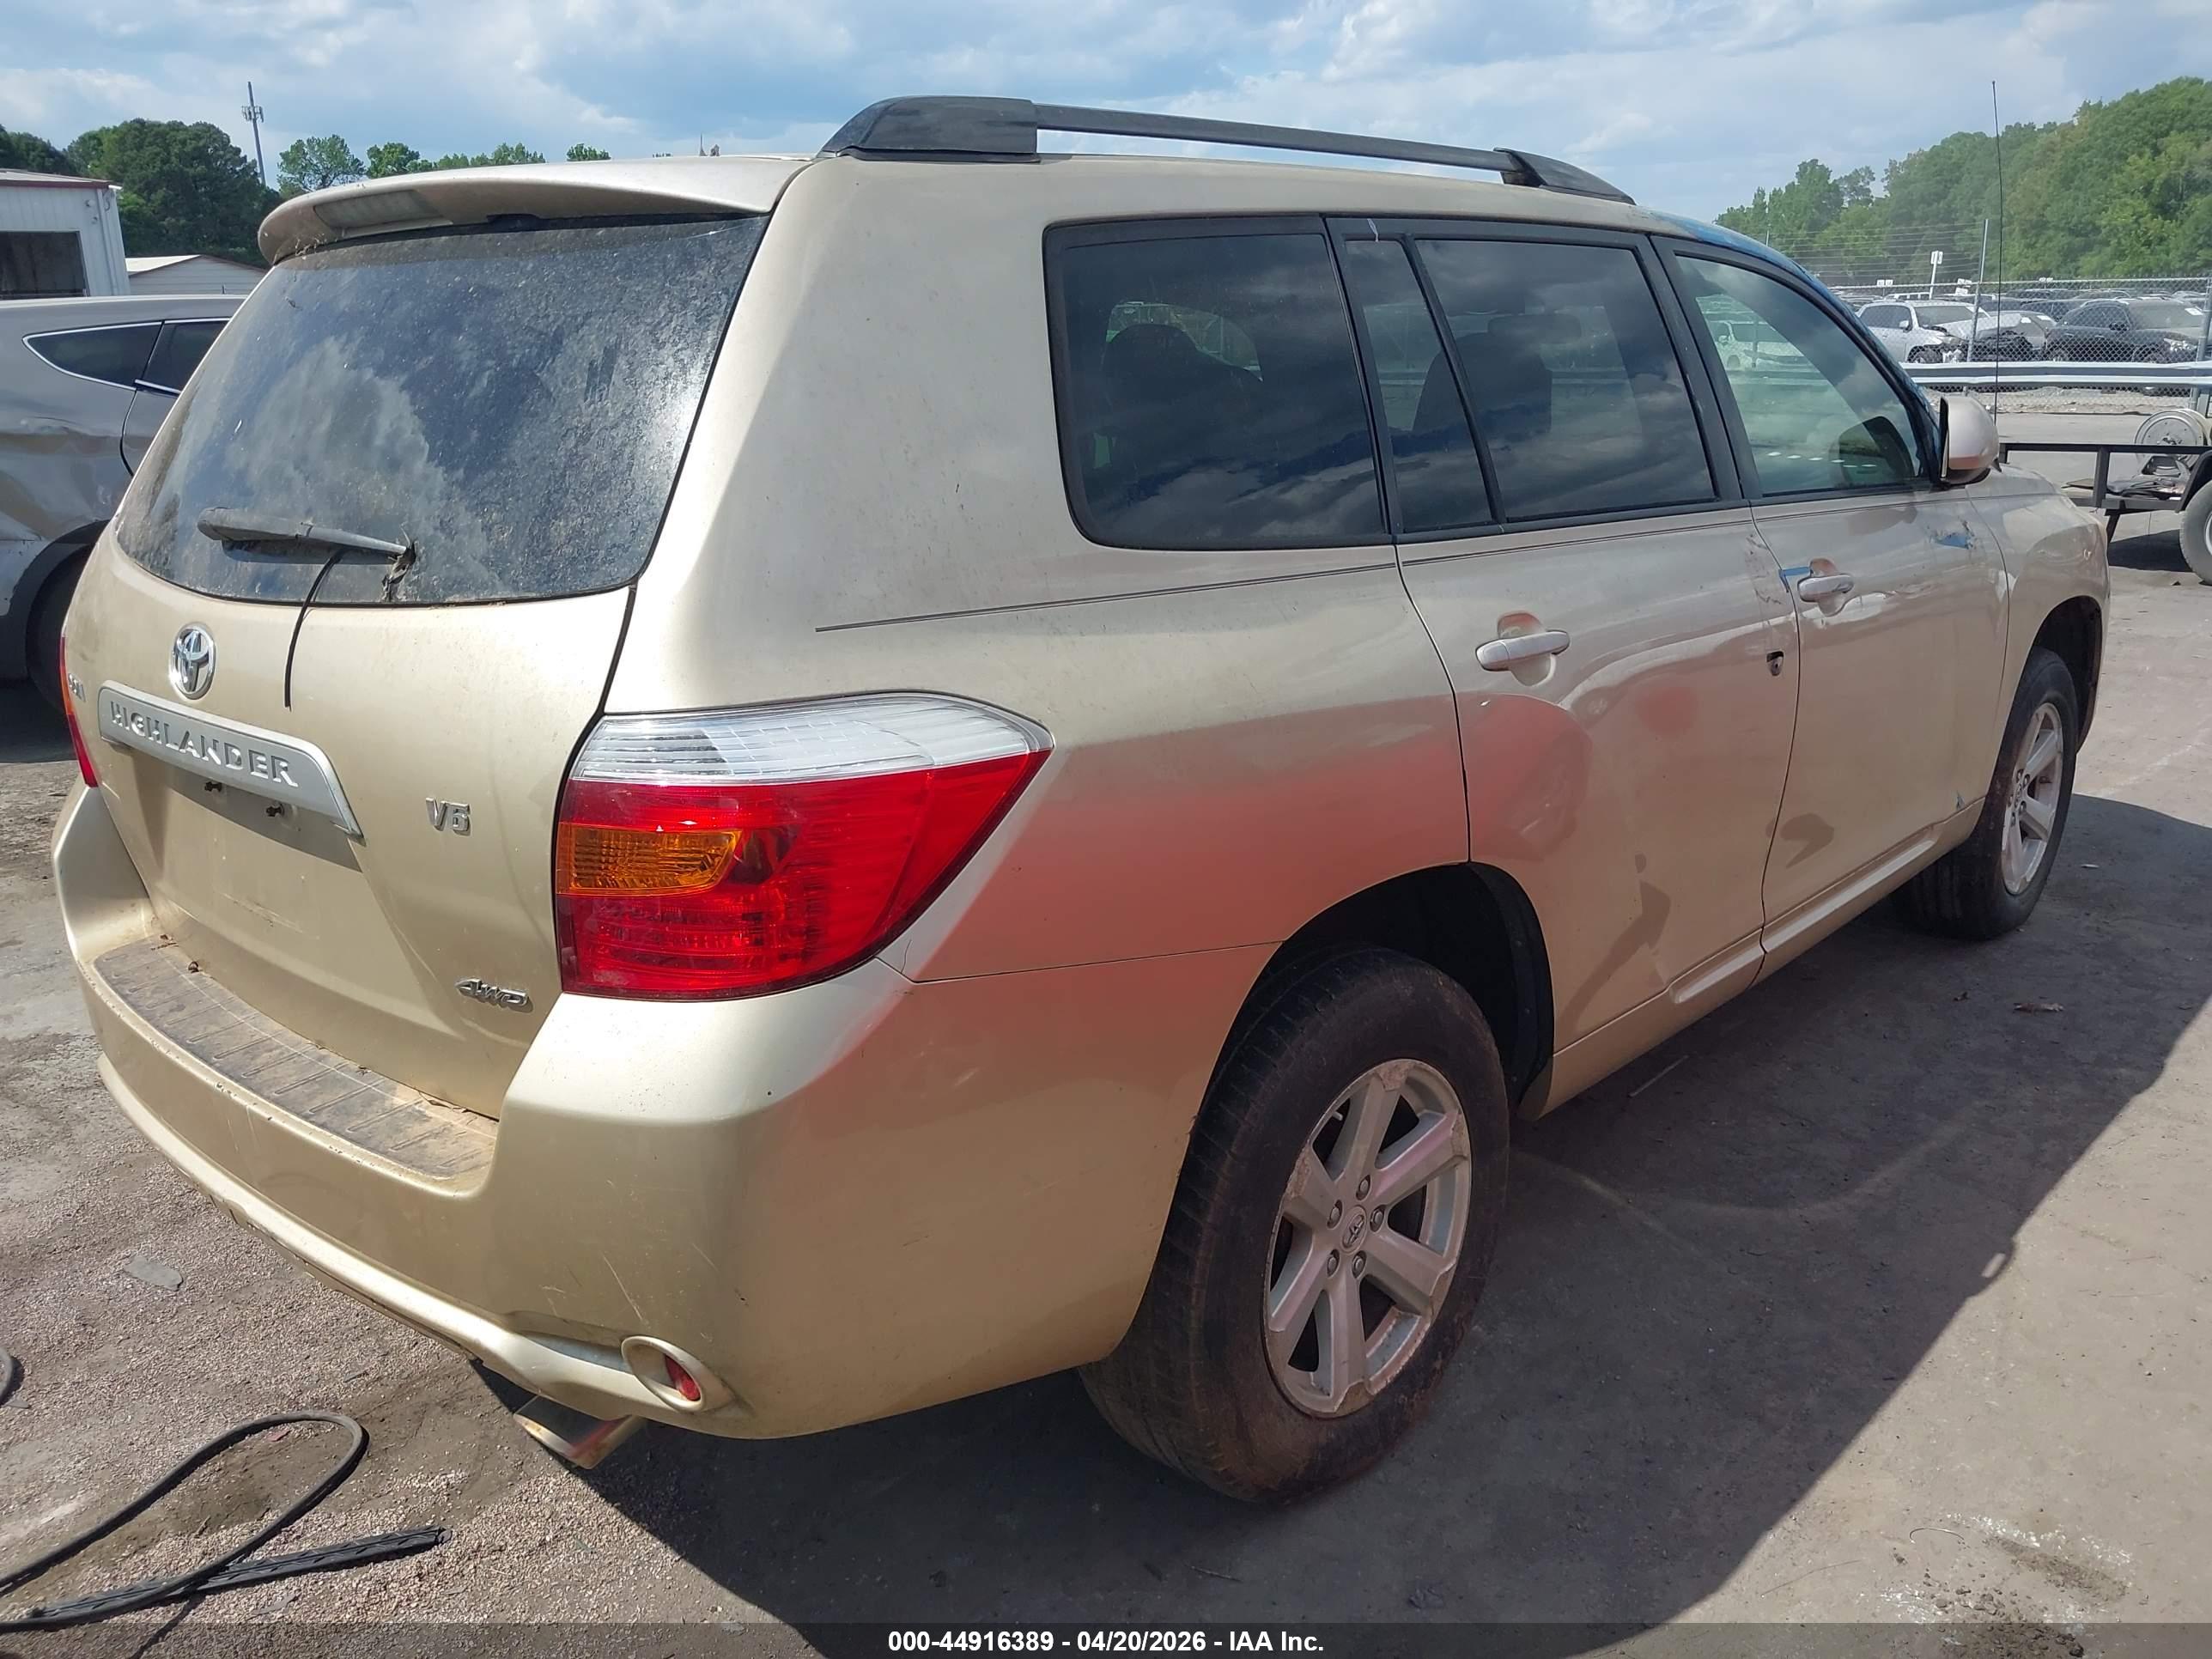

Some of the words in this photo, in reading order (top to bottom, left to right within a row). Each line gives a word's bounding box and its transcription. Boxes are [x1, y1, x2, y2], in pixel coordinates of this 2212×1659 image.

[110, 701, 299, 788] HIGHLANDER
[425, 797, 471, 836] V6
[453, 977, 532, 1011] 4WD
